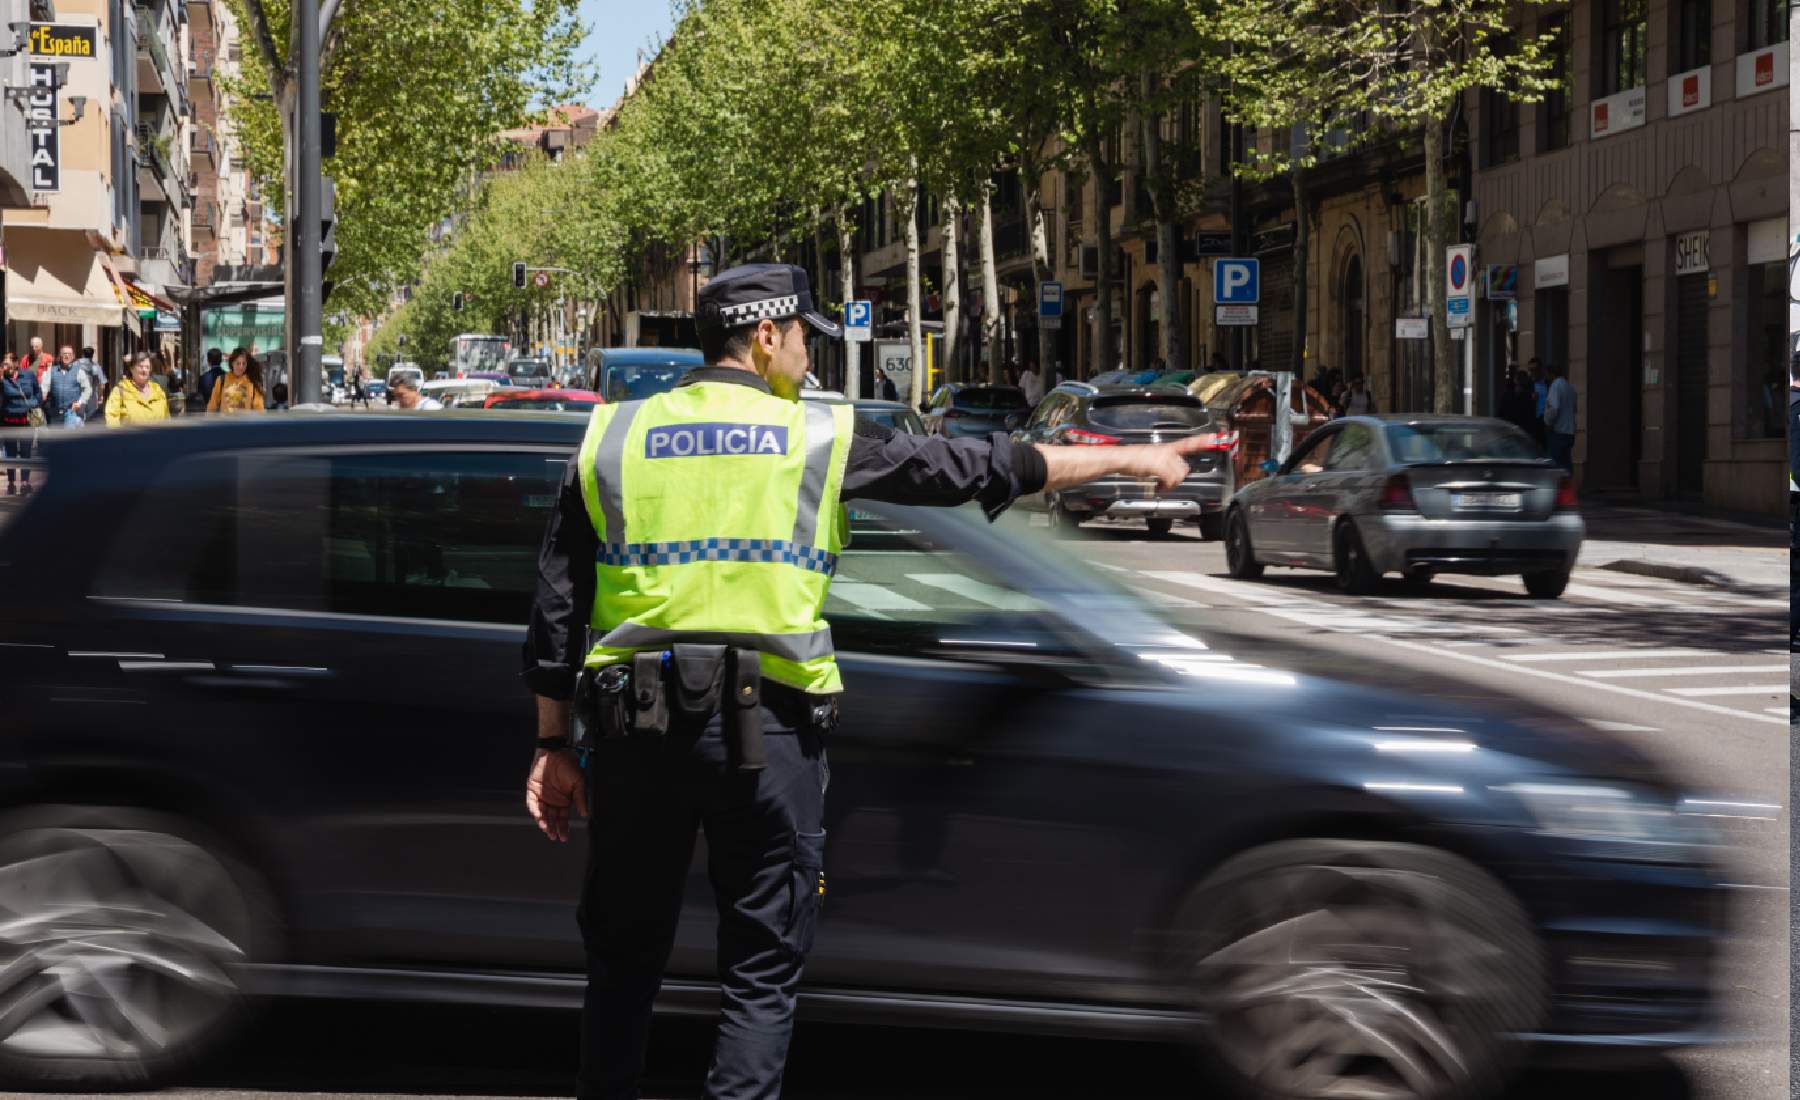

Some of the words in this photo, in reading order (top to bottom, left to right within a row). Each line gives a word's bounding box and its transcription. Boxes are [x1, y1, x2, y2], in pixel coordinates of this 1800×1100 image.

[40, 26, 91, 56] España
[1223, 264, 1250, 298] P
[849, 304, 866, 325] P
[651, 425, 781, 457] POLICÍA
